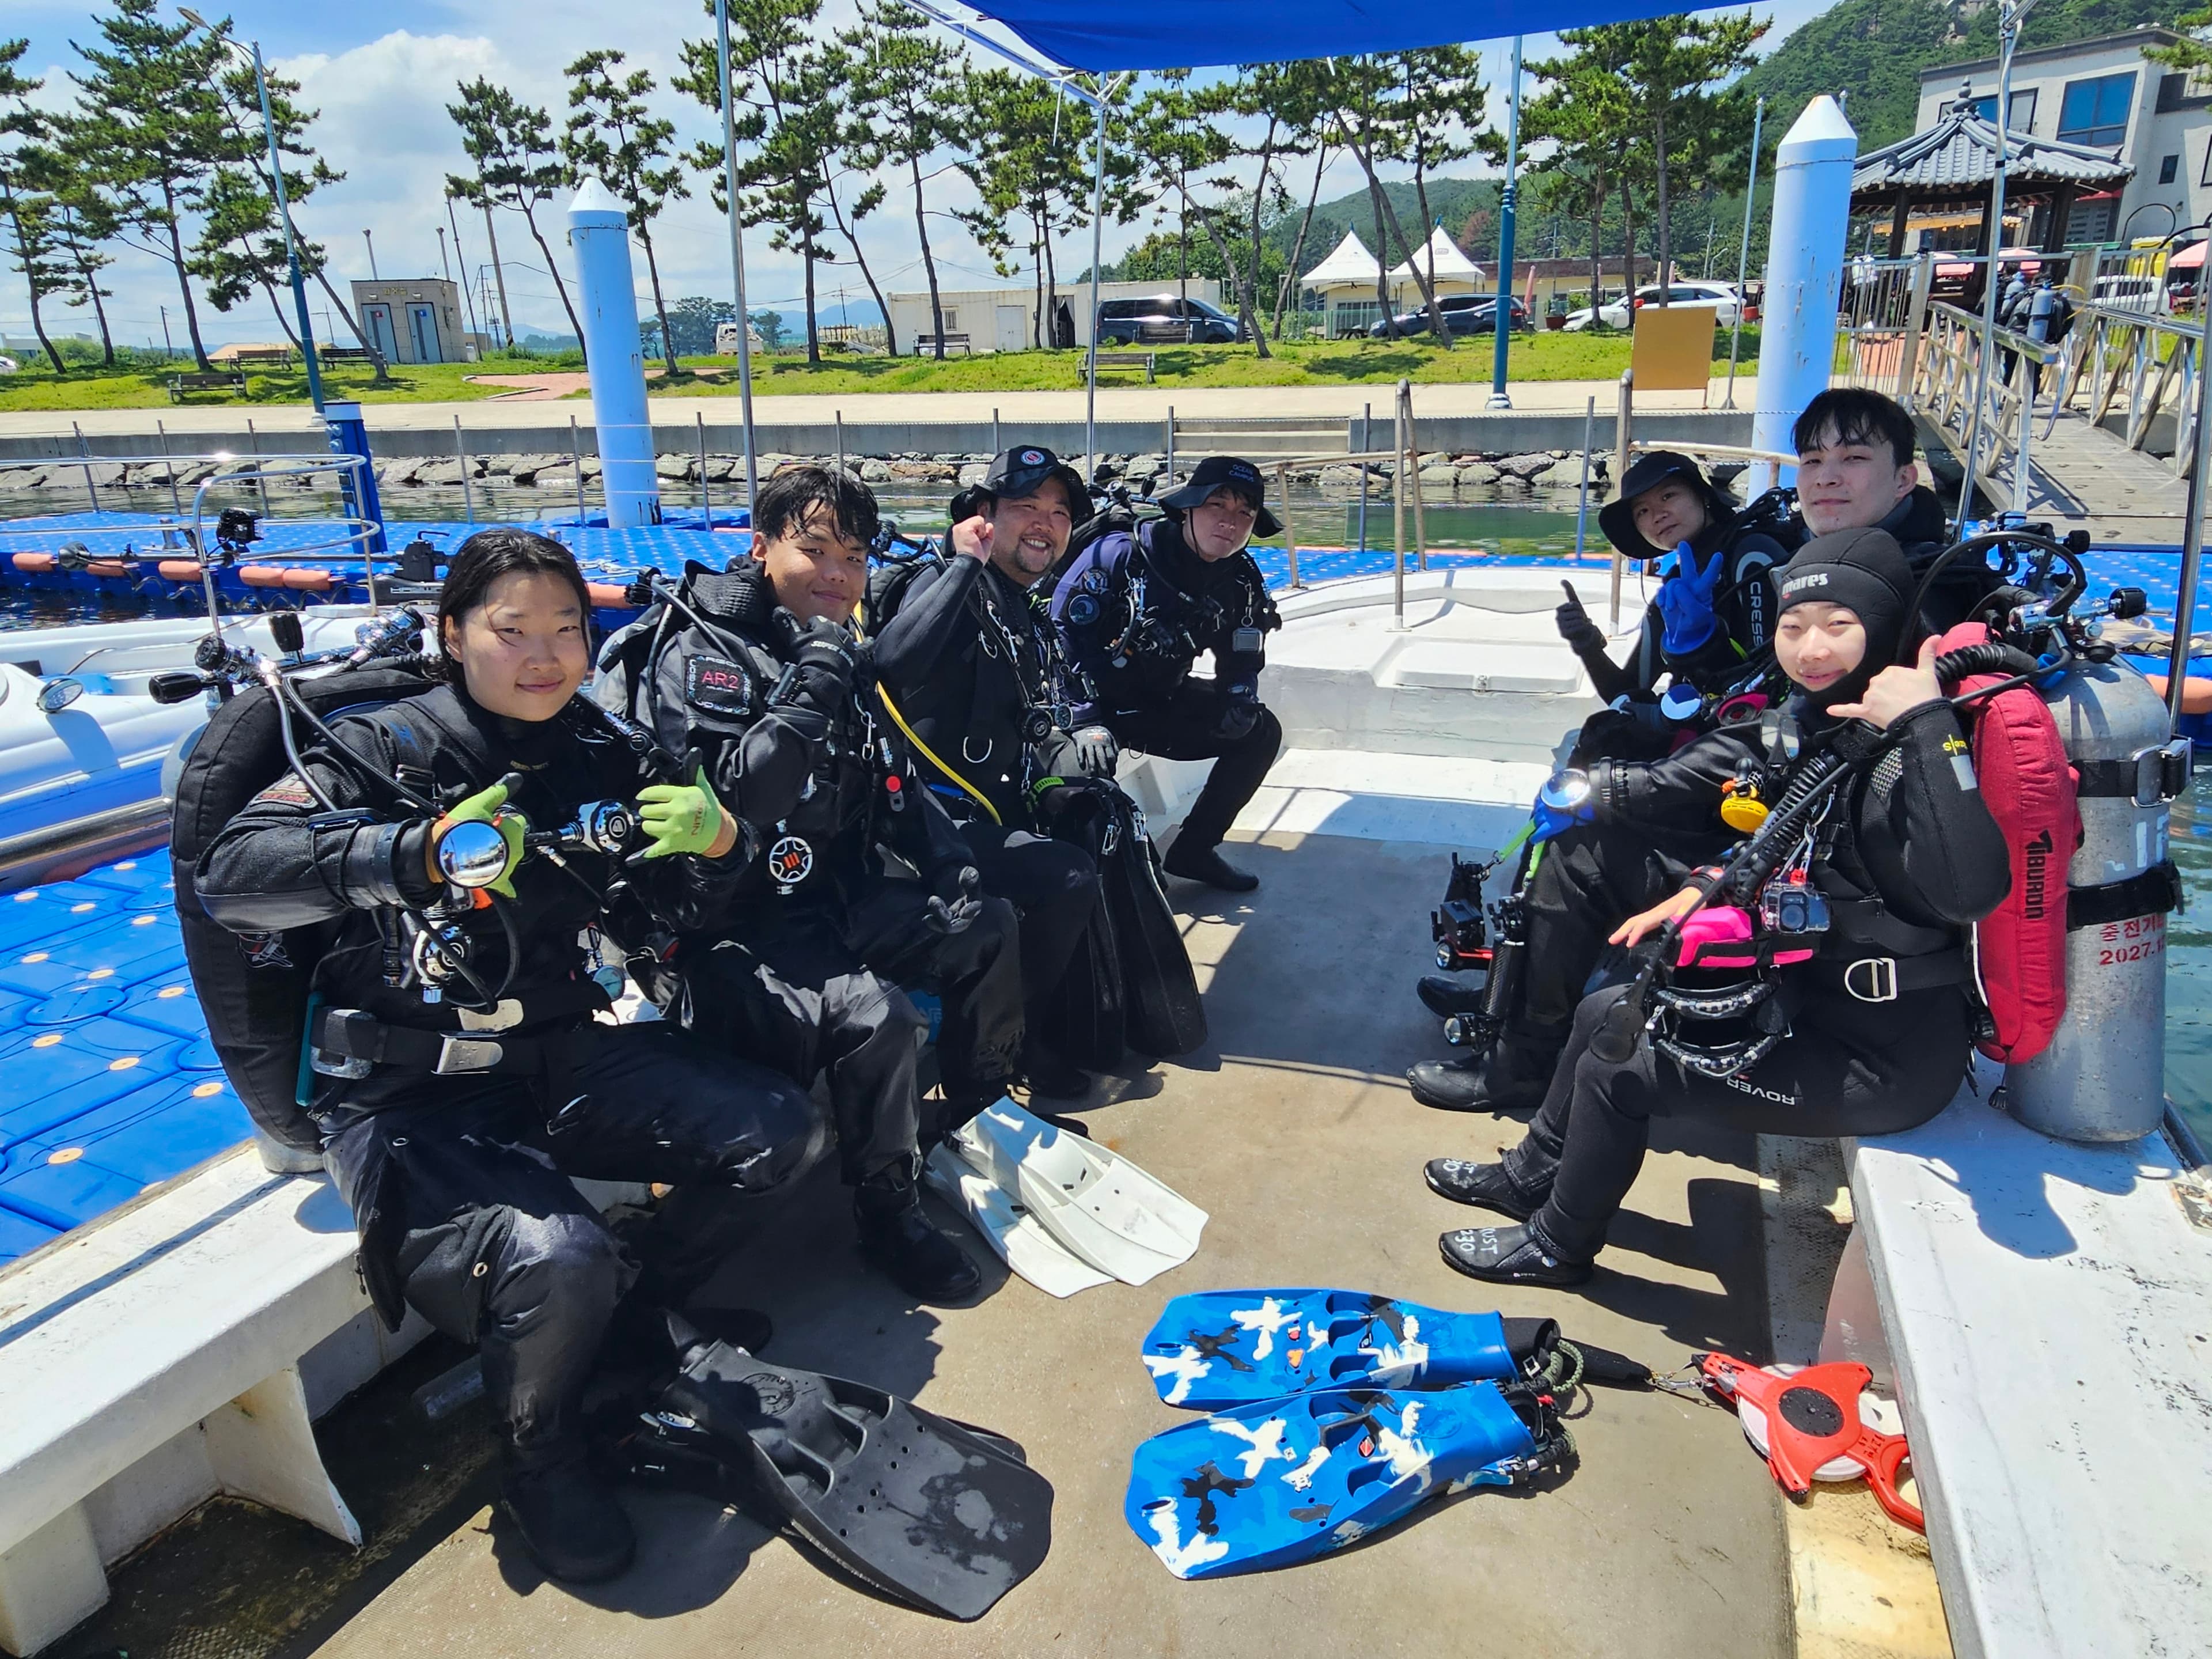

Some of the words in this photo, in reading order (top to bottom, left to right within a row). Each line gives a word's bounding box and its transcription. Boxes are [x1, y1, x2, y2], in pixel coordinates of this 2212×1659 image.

[1782, 573, 1828, 596] mares
[810, 641, 839, 652] SUPER
[702, 670, 739, 689] AR2
[1726, 1076, 1796, 1105] ROVER
[1455, 1229, 1475, 1252] 230
